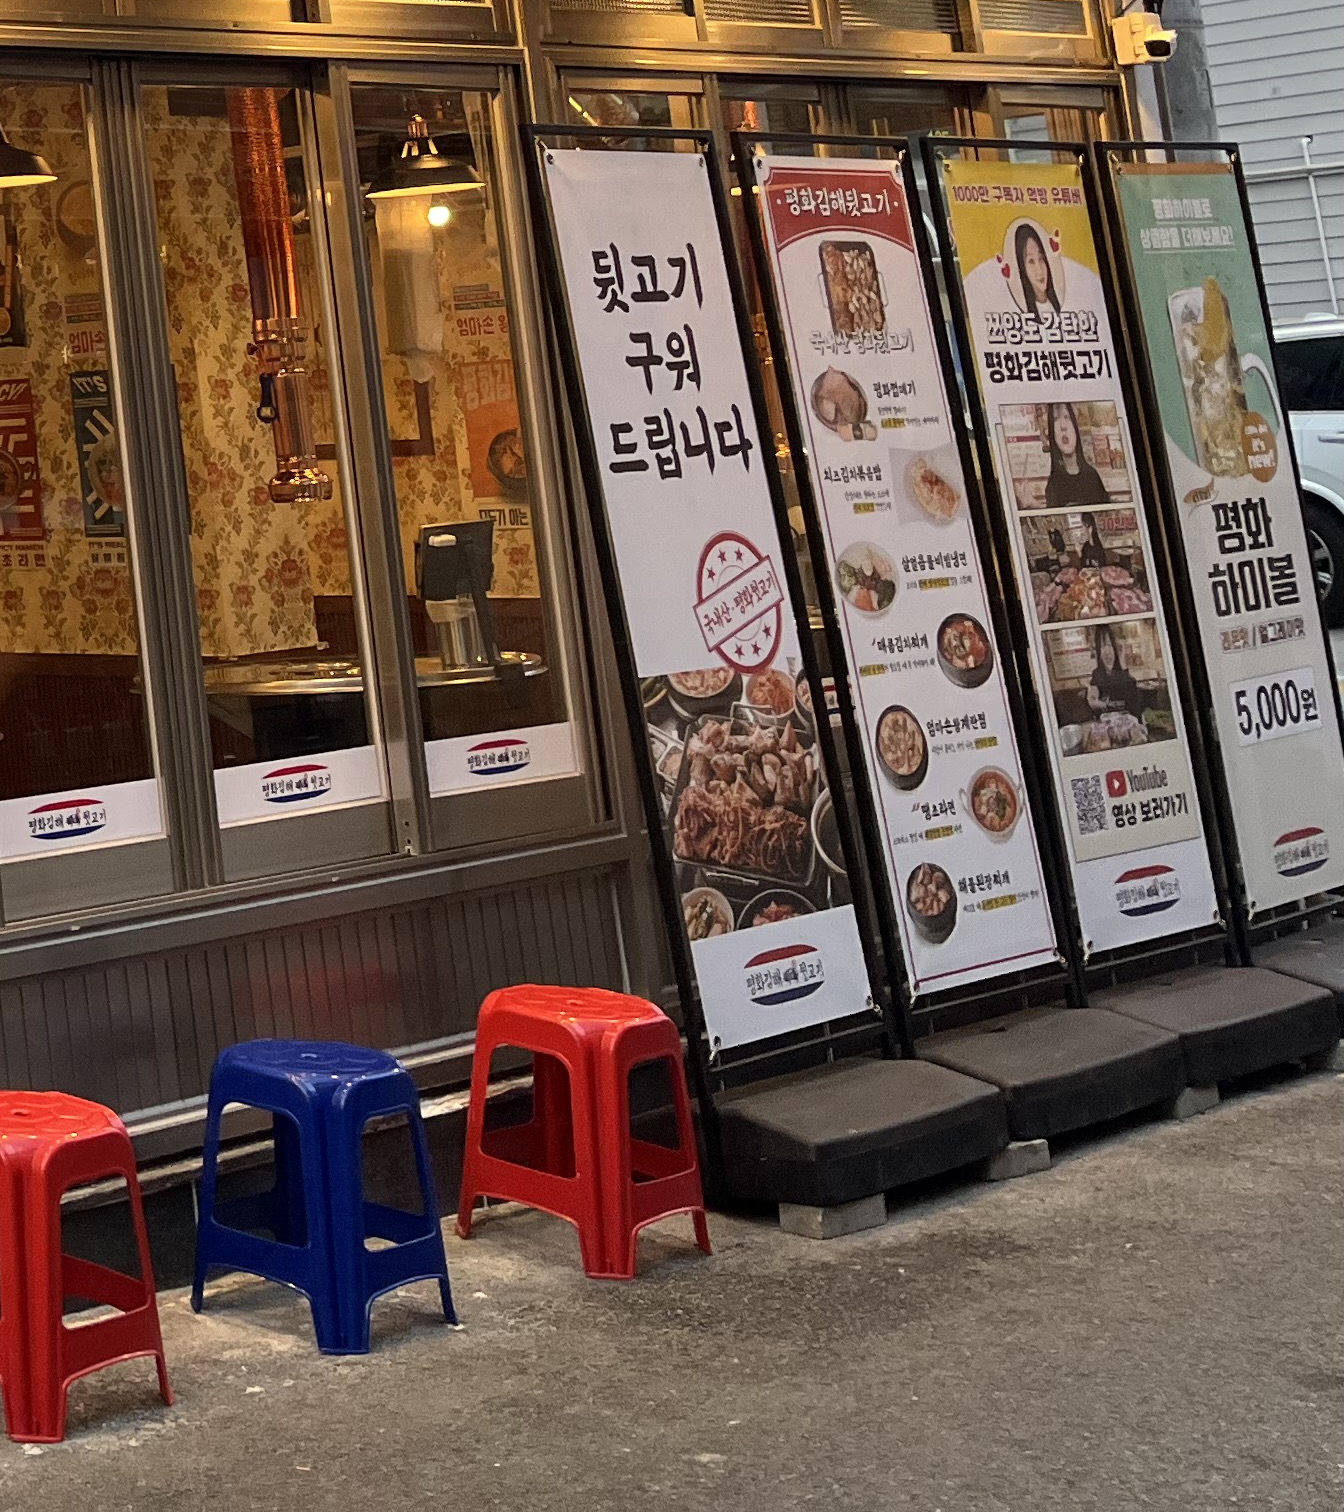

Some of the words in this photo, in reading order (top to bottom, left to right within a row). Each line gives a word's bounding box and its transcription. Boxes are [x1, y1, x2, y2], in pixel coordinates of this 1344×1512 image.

[784, 187, 891, 217] 평화김해뒷고기
[952, 185, 989, 204] 1000만
[992, 186, 1025, 204] 구독자
[1051, 186, 1083, 206] 유튜버
[591, 242, 704, 313] 뒷고기
[985, 311, 1043, 345] 쯔양도
[1043, 309, 1100, 344] 감탄한
[625, 324, 701, 395] 구워
[984, 349, 1112, 384] 평화김해뒷고기
[609, 403, 753, 481] 드립니다
[1212, 497, 1274, 555] 평화
[1208, 553, 1301, 617] 하이볼
[1235, 680, 1319, 739] 5,000원
[1127, 764, 1169, 794] YouTube
[1112, 803, 1137, 829] 영상
[1141, 792, 1189, 823] 보러가기
